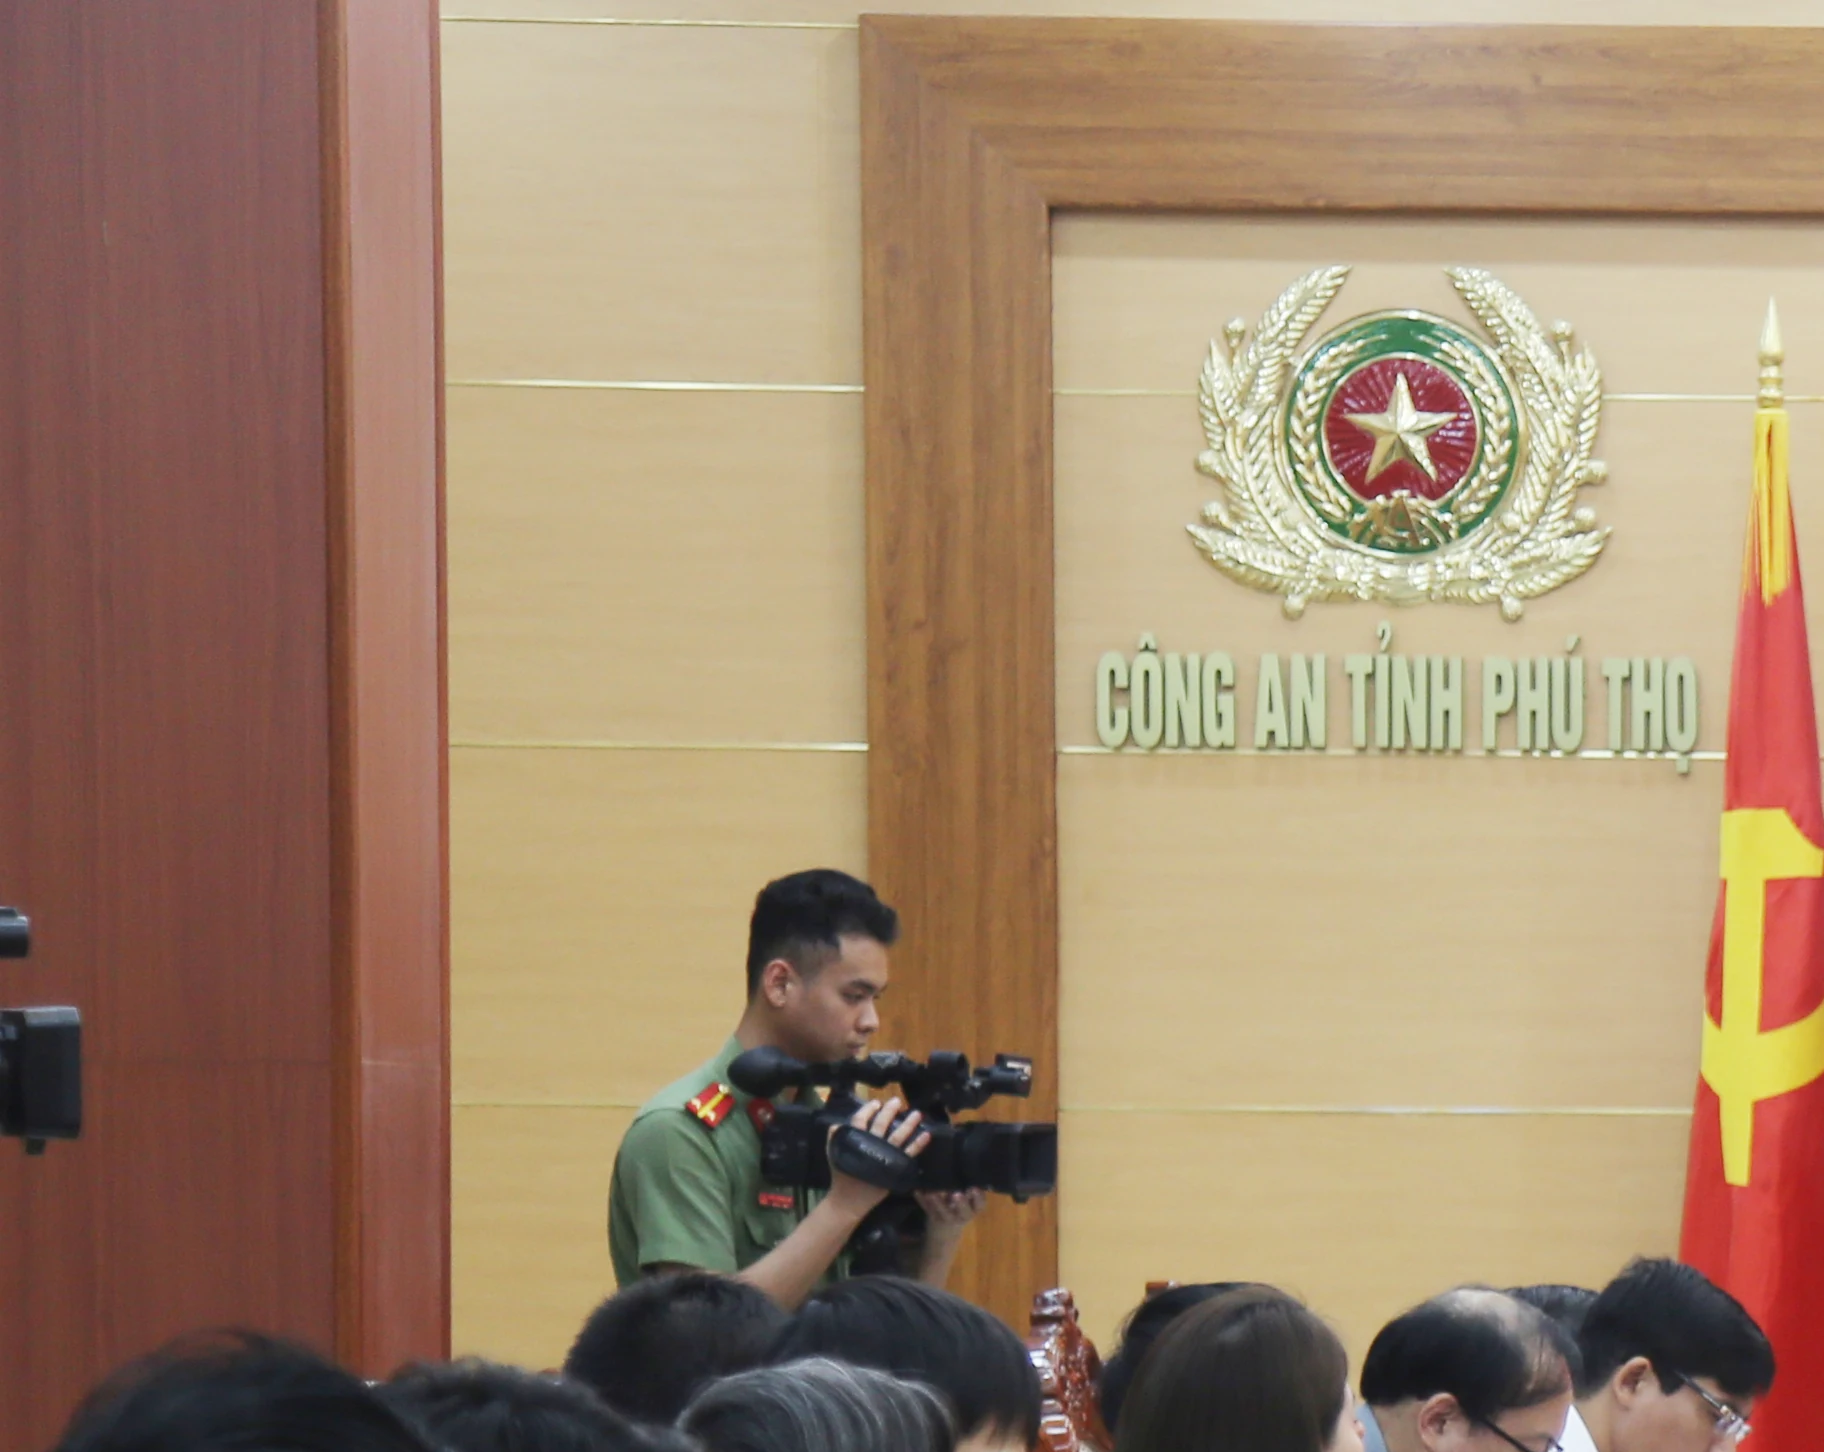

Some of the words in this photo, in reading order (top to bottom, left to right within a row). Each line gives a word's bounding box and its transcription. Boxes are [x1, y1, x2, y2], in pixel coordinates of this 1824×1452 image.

[1096, 633, 1237, 749] CÔNG
[1254, 653, 1327, 750] AN
[1344, 621, 1464, 751] TỈNH
[1482, 635, 1586, 753] PHÚ
[1602, 656, 1699, 775] THỌ
